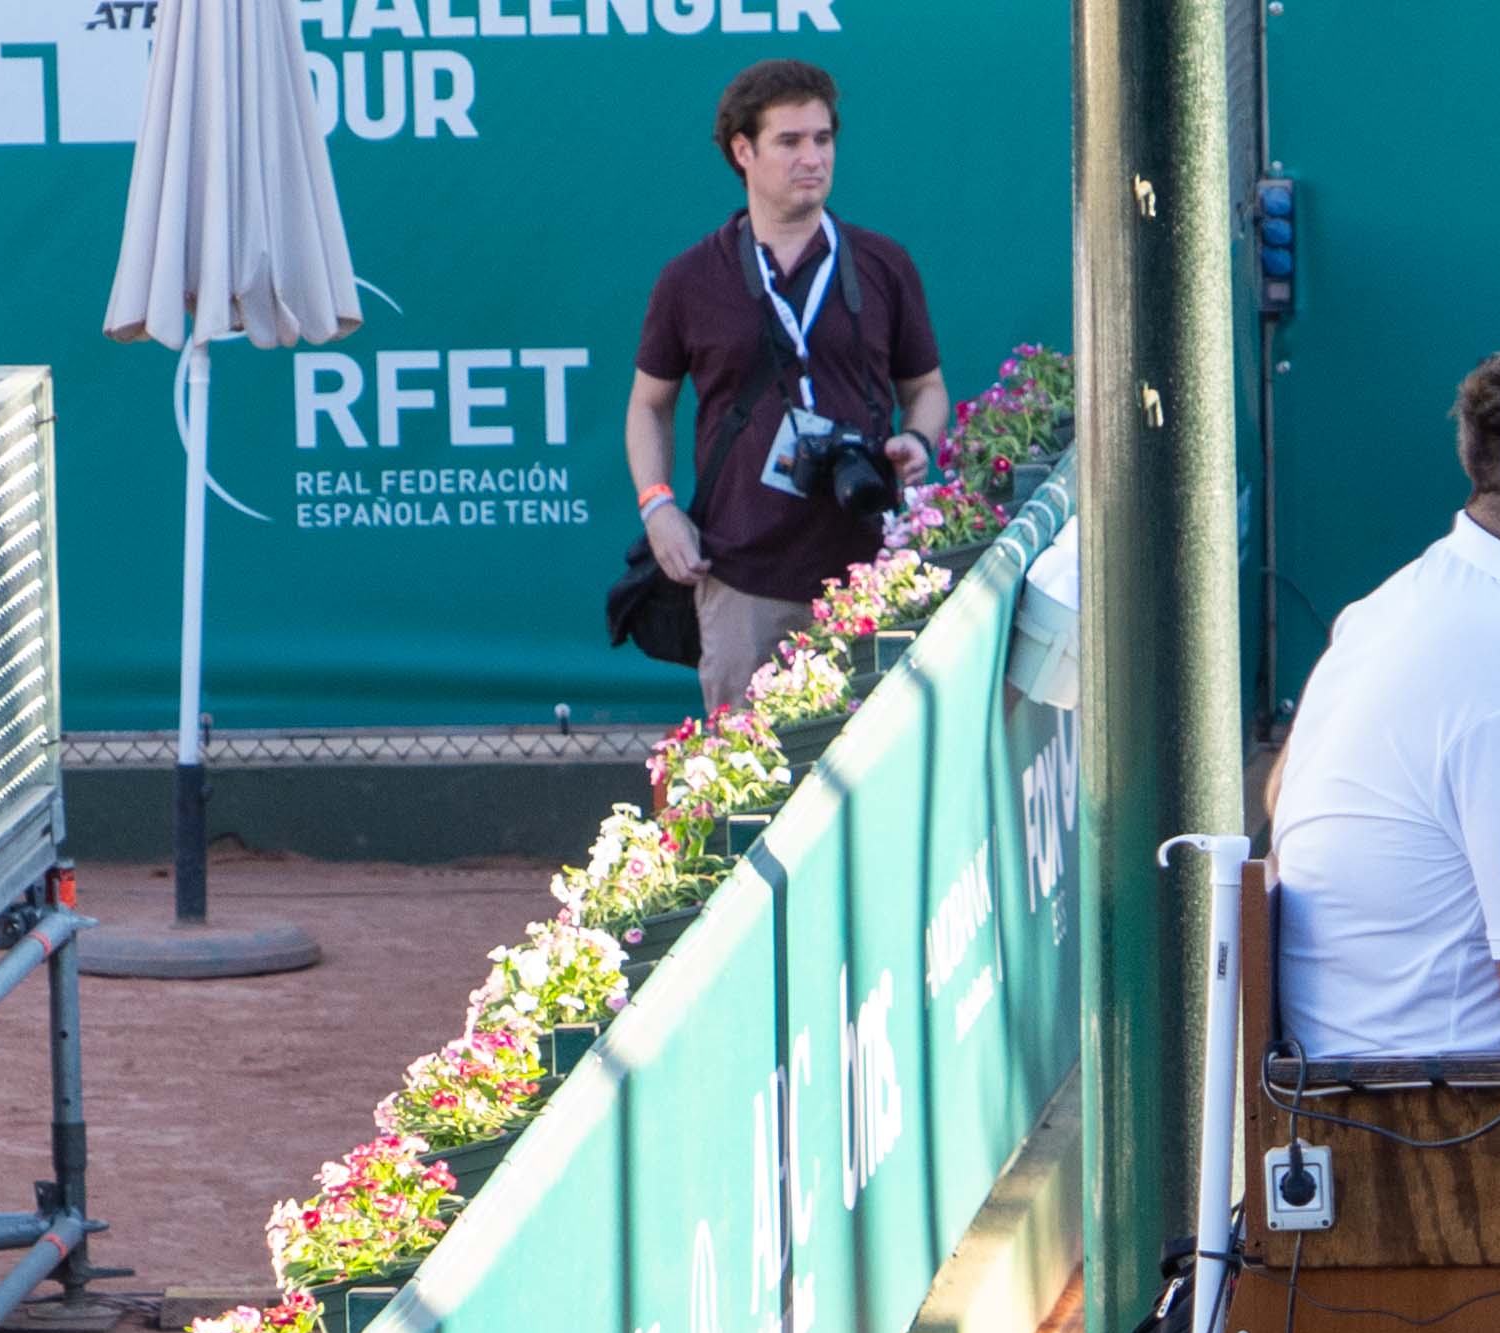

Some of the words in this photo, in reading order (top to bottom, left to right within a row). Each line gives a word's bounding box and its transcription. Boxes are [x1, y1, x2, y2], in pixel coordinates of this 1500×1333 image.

[299, 0, 842, 39] HALLENGER
[303, 49, 479, 140] UR
[293, 348, 589, 448] RFET
[295, 471, 371, 495] REAL
[381, 461, 567, 493] FEDERACIÓN
[296, 497, 450, 528] ESPAÑOLA
[459, 500, 496, 526] DE
[503, 499, 589, 524] TENIS
